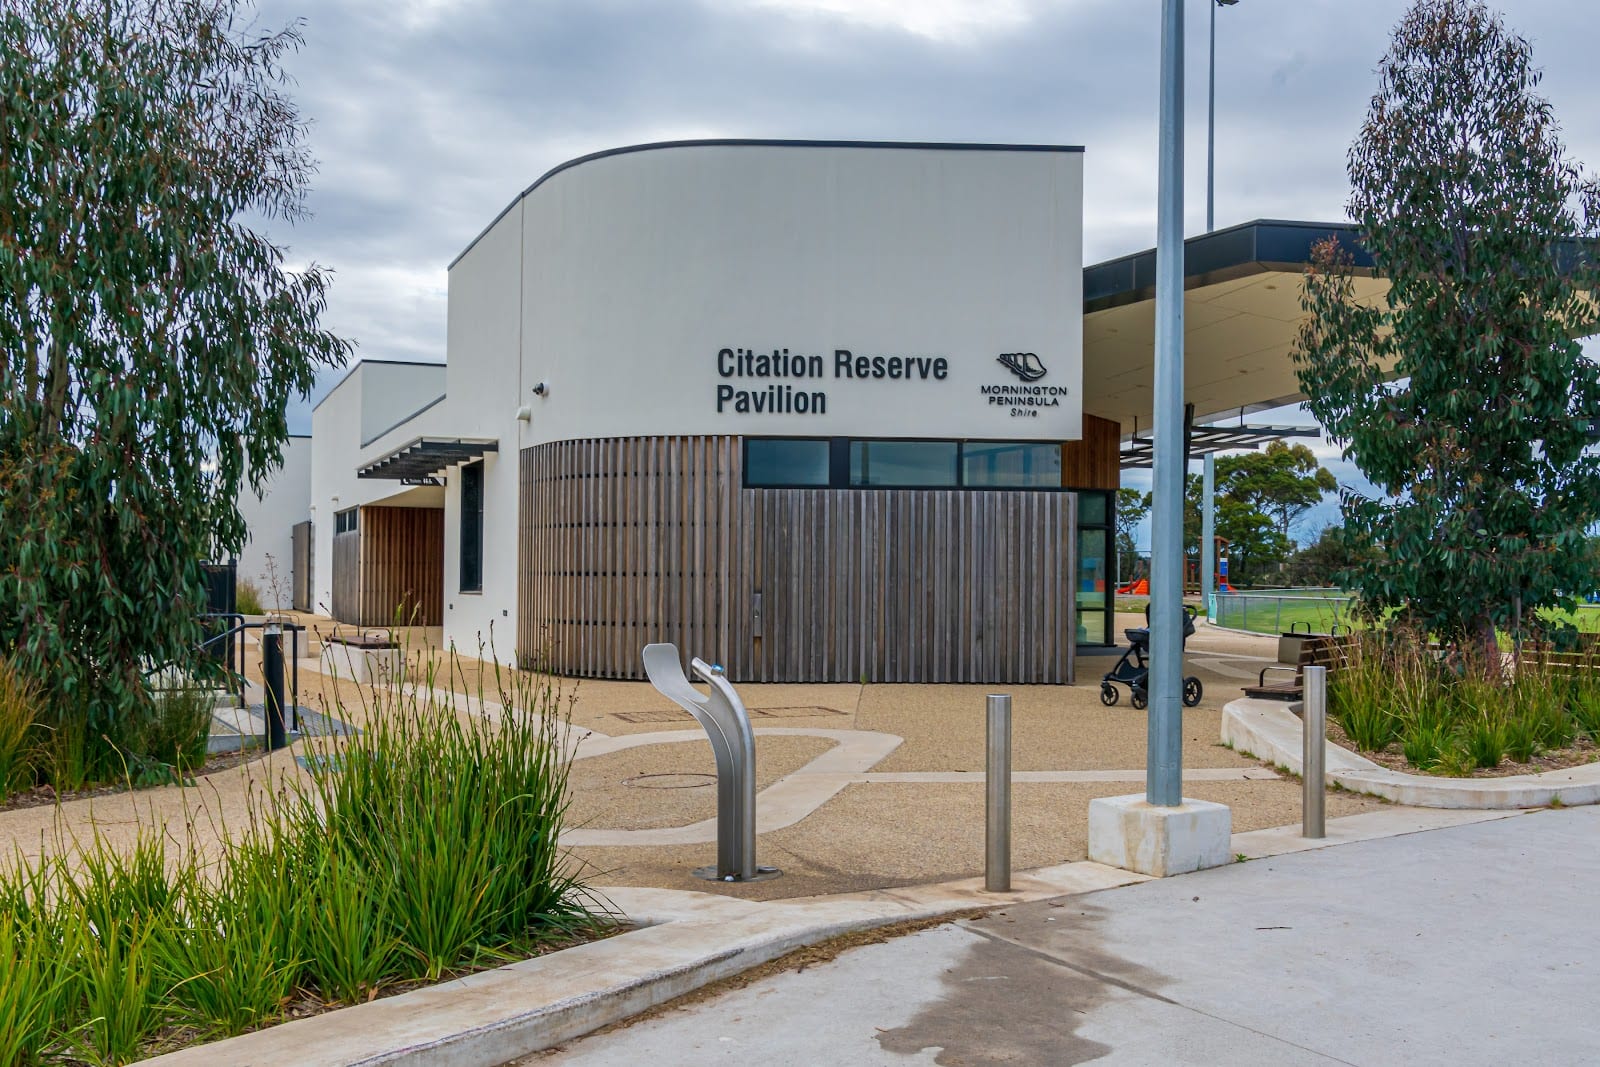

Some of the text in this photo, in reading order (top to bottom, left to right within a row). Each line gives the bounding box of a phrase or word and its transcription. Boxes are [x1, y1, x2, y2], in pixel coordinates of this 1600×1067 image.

[718, 348, 948, 380] Citation Reserve
[980, 385, 1067, 396] MORNINGTON
[717, 384, 826, 414] Pavilion
[988, 396, 1059, 407] PENINSULA
[1010, 407, 1038, 417] Shire
